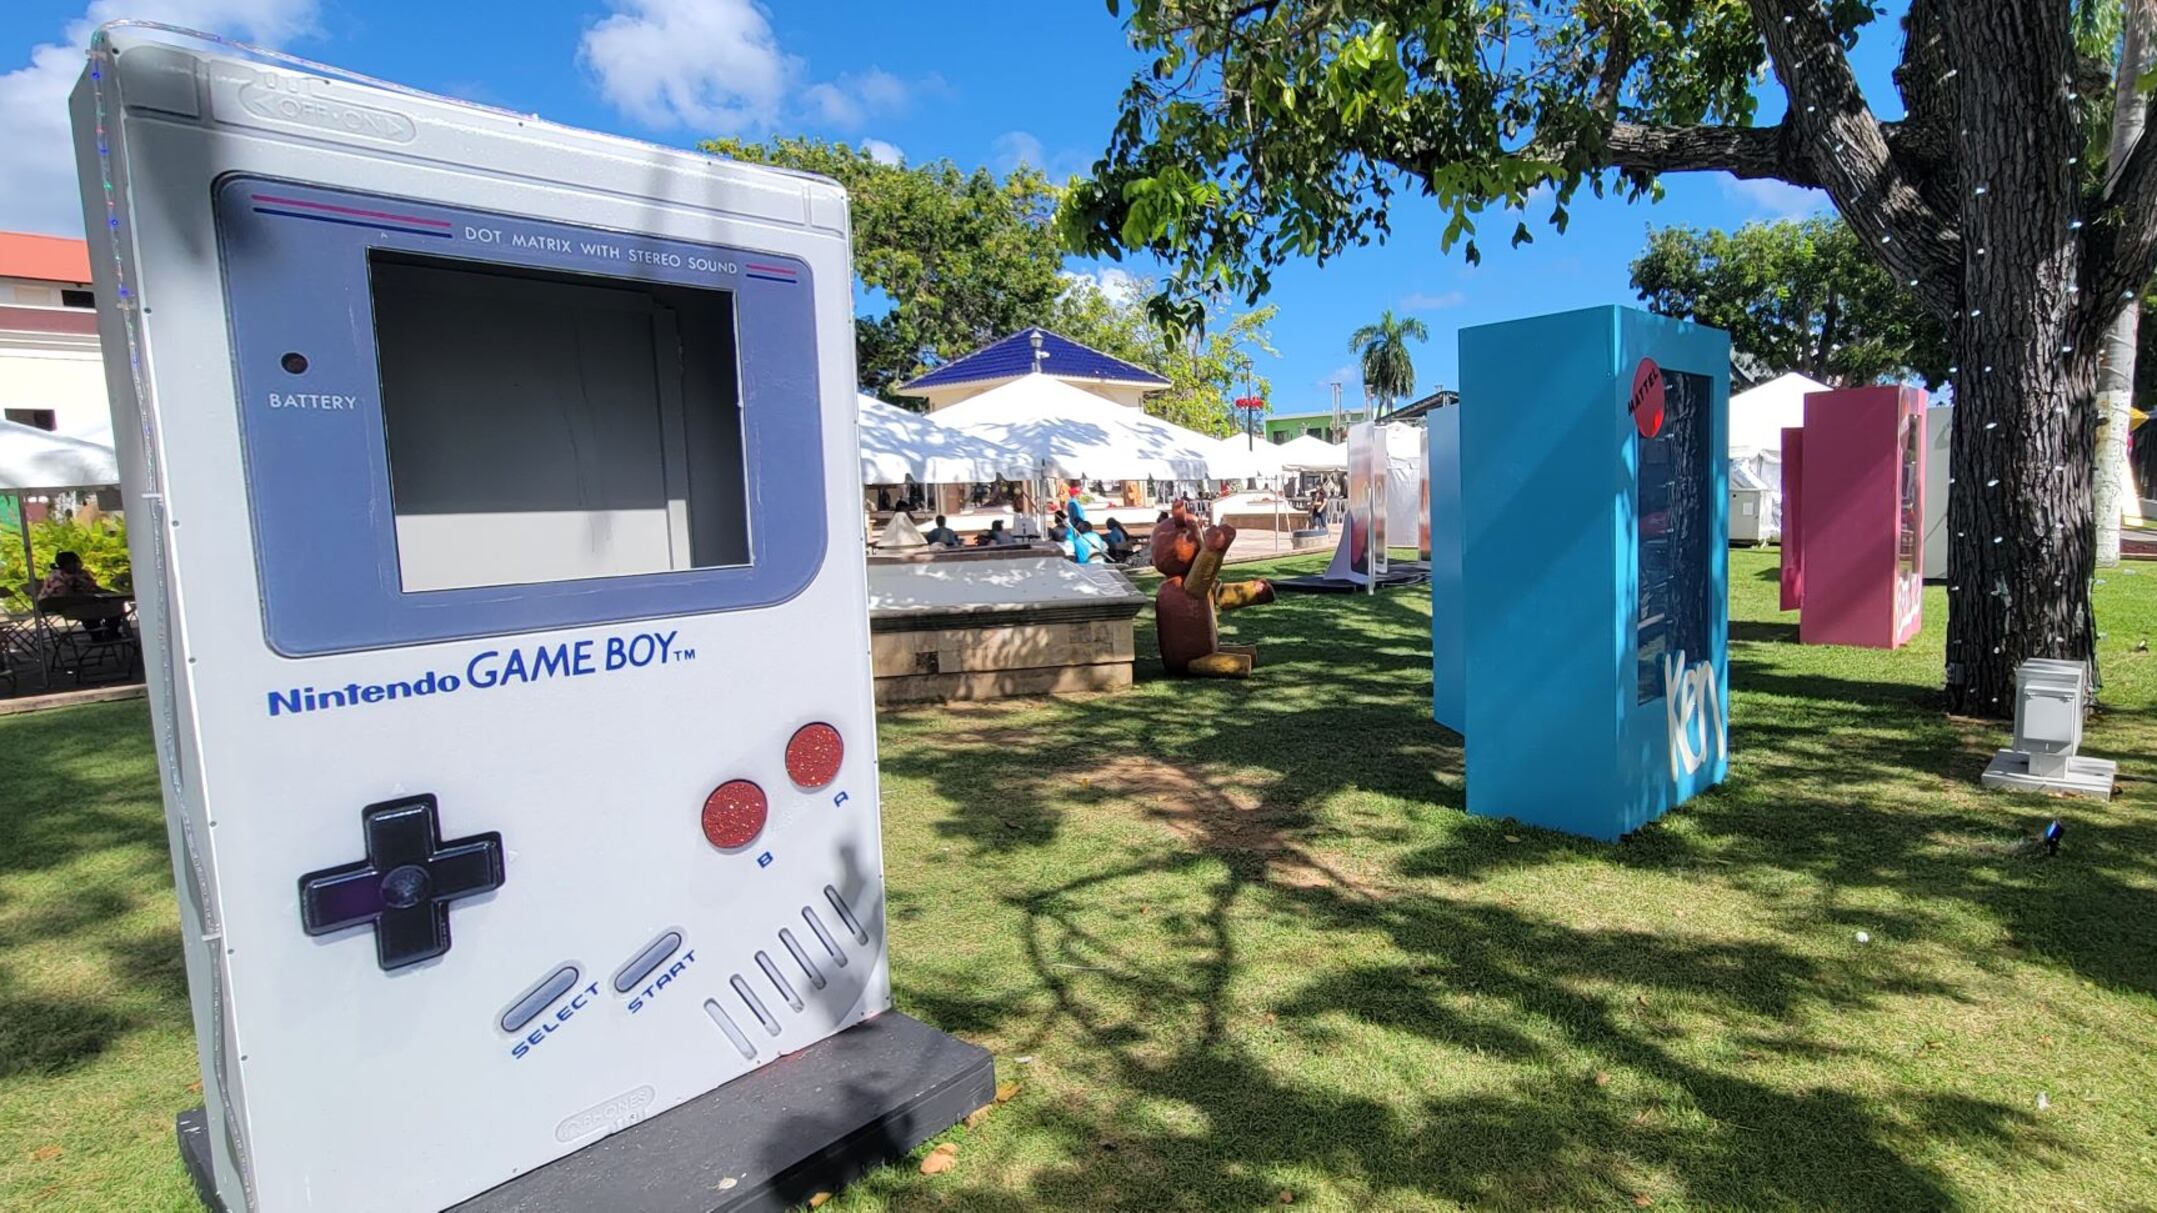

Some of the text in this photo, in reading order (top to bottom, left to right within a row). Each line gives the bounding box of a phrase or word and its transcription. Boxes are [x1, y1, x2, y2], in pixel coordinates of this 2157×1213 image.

[465, 226, 738, 274] DOT MATRIX WITH STEREO SOUND
[268, 393, 357, 410] BATTERY
[1627, 367, 1659, 416] MATTEL
[267, 671, 460, 716] Nintendo
[466, 640, 596, 689] GAME
[1664, 649, 1726, 783] Ken
[833, 791, 849, 808] A
[757, 852, 774, 868] B
[627, 949, 695, 1014] START
[511, 981, 599, 1060] SELECT
